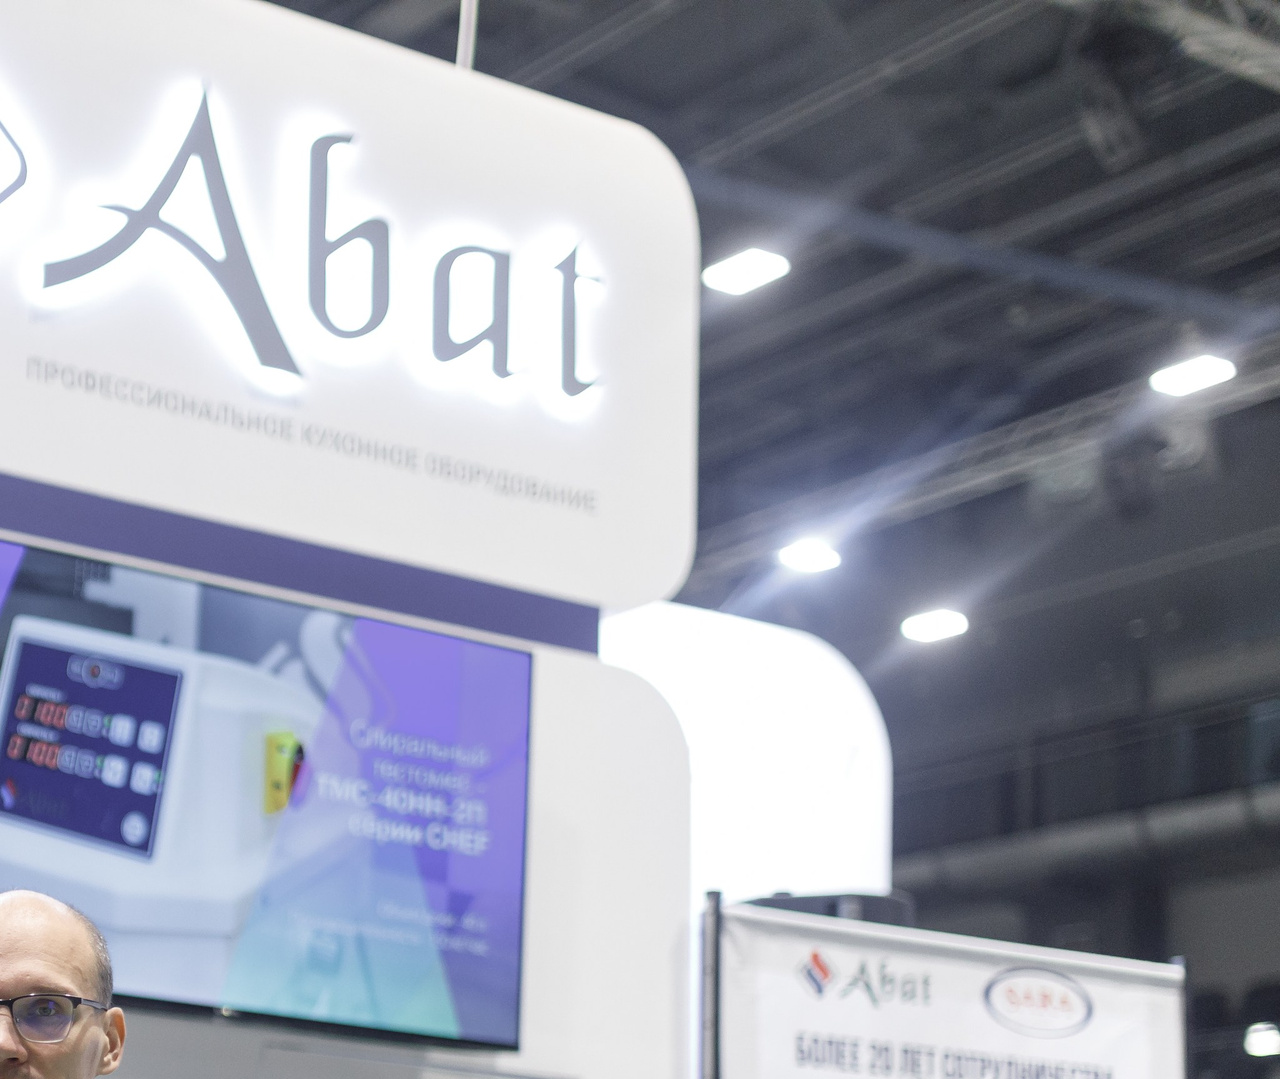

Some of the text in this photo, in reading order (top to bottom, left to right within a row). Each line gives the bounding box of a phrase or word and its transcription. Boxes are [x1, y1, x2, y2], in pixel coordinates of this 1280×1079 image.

[42, 87, 603, 397] Abat
[25, 356, 597, 513] ПРОФЕССИОНАЛЬНОЕ КУХОННОЕ ОБОРУДОВАНИЕ
[840, 958, 932, 1008] Abat
[795, 1030, 862, 1074] БОЛЕЕ
[868, 1038, 894, 1077] 20
